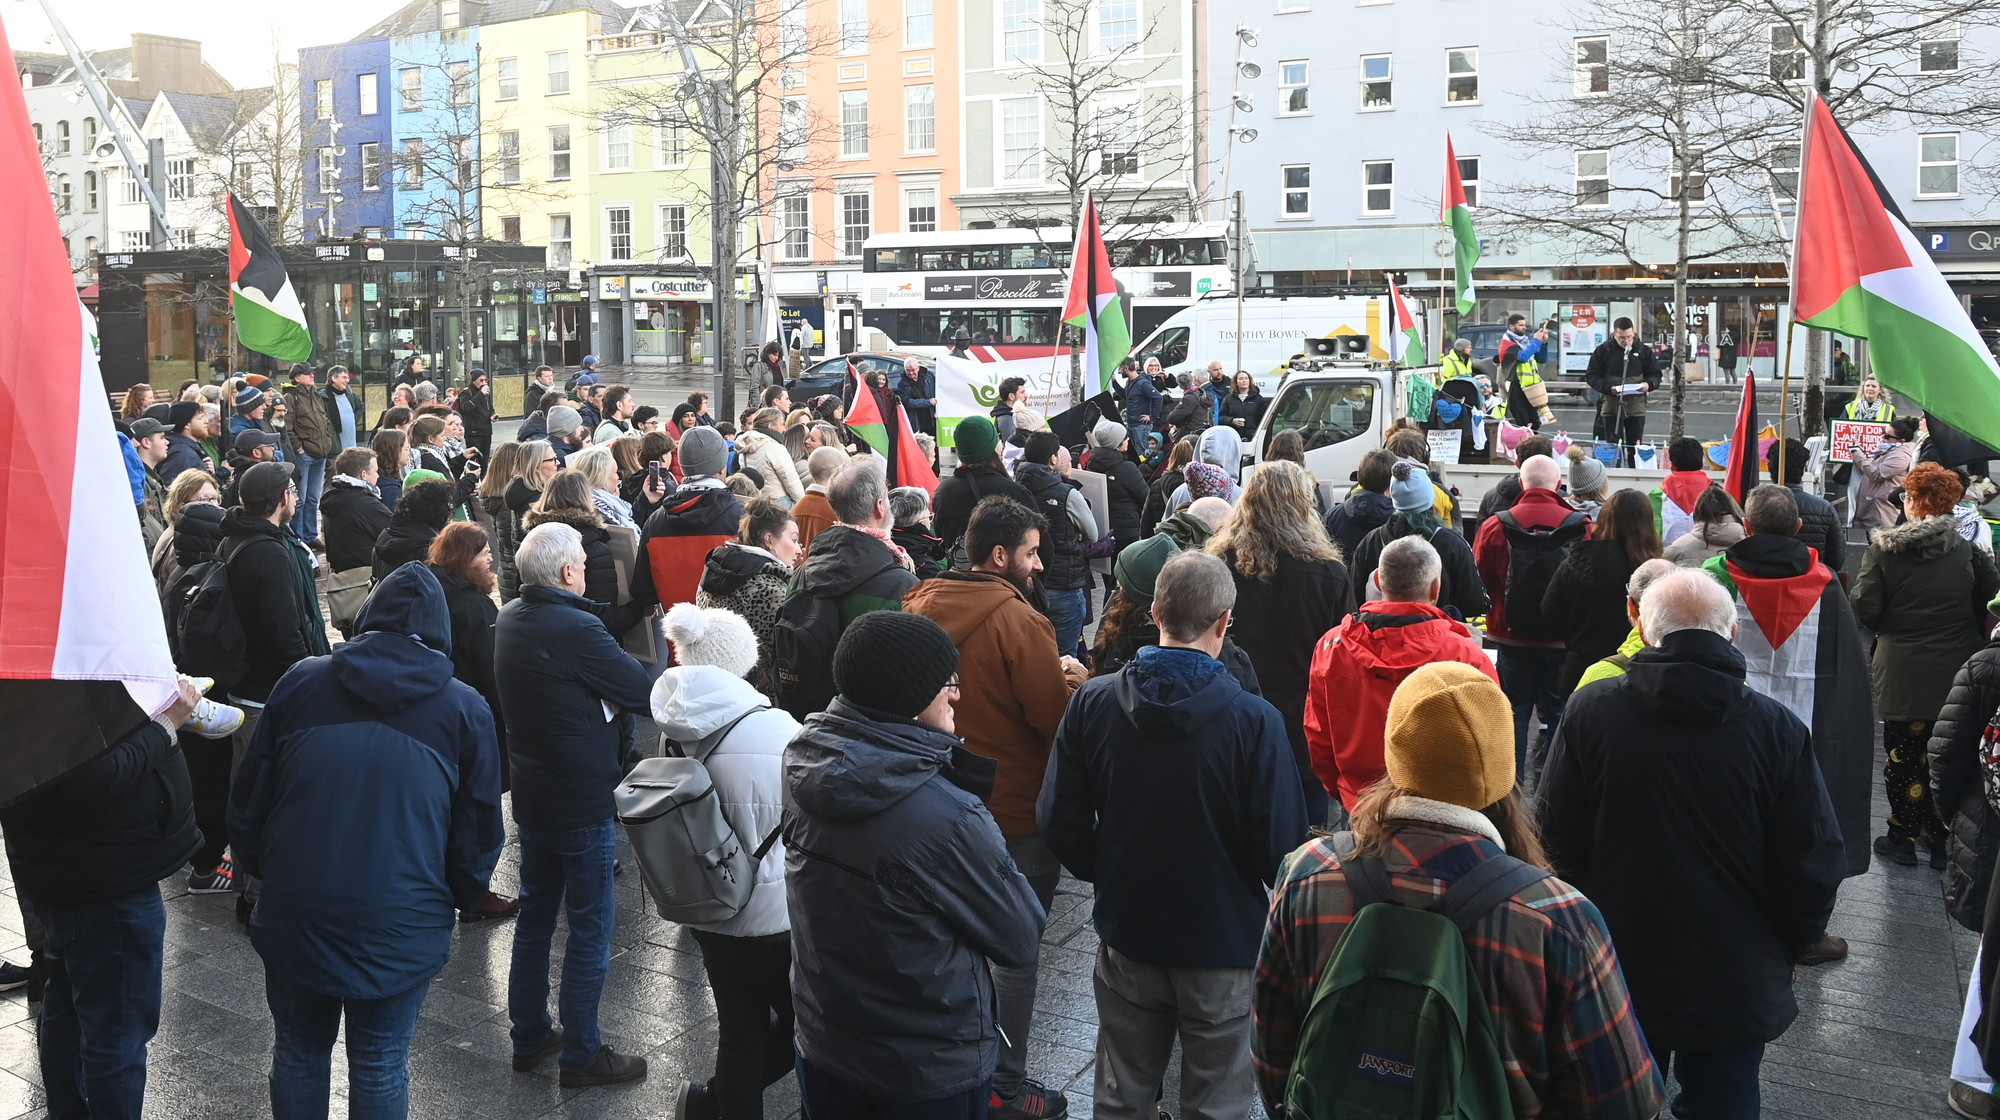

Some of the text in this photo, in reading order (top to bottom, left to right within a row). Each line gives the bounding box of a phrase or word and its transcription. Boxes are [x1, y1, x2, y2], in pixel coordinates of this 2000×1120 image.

[1931, 234, 1944, 250] P
[315, 245, 350, 258] THREE FOOLS
[443, 246, 461, 257] THREE
[652, 280, 707, 293] Costcutter
[977, 276, 1041, 299] Priscilla
[780, 309, 801, 317] To Let
[1269, 329, 1308, 339] BOWEN
[1835, 423, 1848, 433] IF
[1849, 425, 1864, 435] YOU
